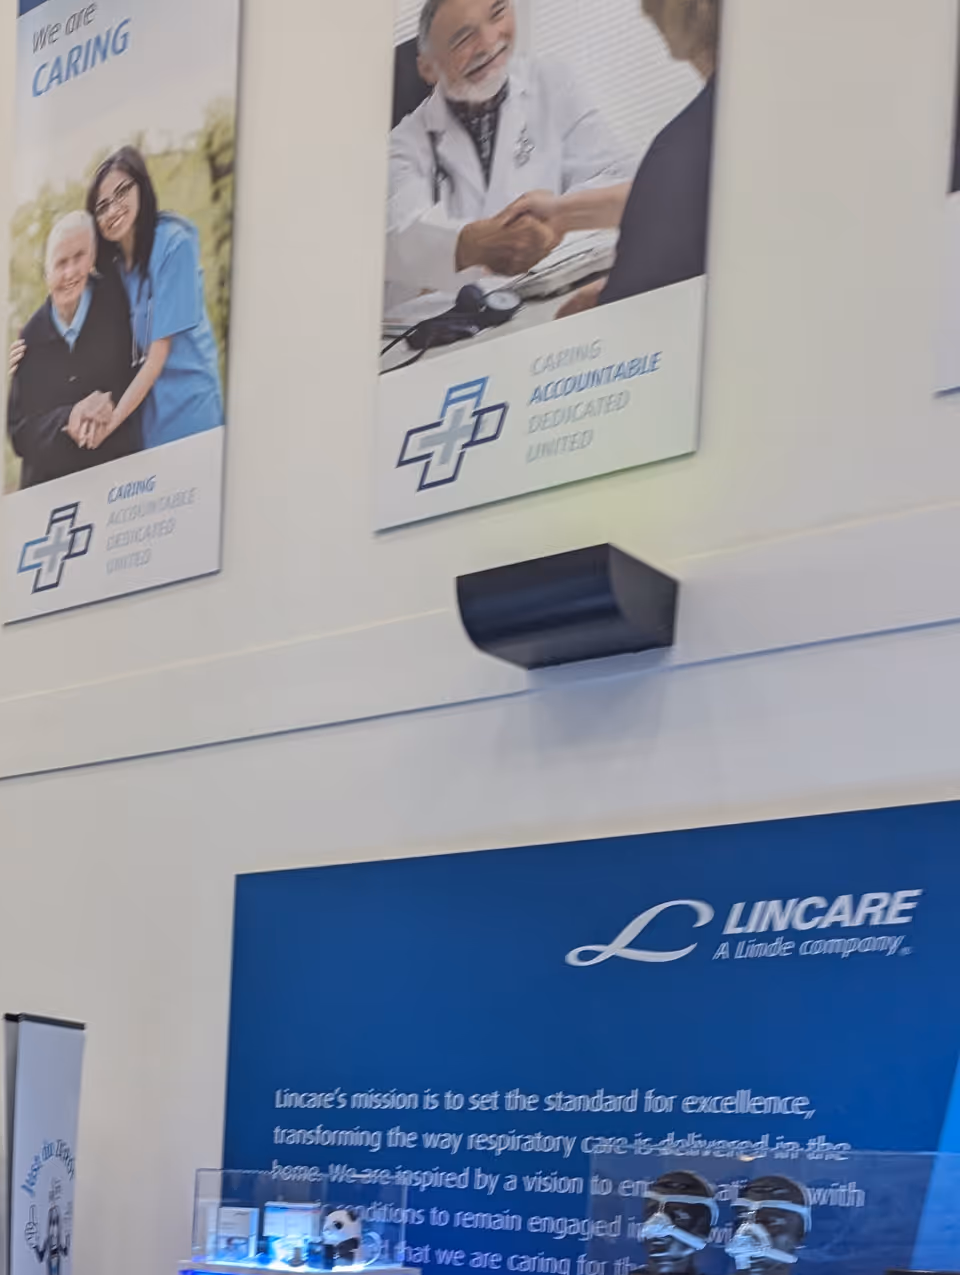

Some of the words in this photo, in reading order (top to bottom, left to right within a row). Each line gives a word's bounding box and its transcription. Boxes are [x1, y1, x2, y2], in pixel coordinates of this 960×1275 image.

[32, 22, 61, 53] We
[65, 3, 97, 36] are
[32, 18, 130, 97] CARING
[529, 338, 603, 376] CARING
[527, 350, 663, 405] ACCOUNTABLE
[527, 389, 631, 433] DEDICATED
[525, 429, 594, 463] UNITED
[107, 475, 156, 504] CARING
[722, 889, 923, 935] LINCARE
[712, 941, 730, 960] A
[734, 936, 795, 959] Linde
[274, 1087, 347, 1109] Lincare's
[351, 1089, 418, 1110] mission
[423, 1089, 439, 1110] is
[444, 1090, 464, 1111] to
[468, 1092, 499, 1112] set
[504, 1088, 539, 1112] the
[543, 1089, 638, 1114] standard
[643, 1089, 677, 1114] for
[681, 1089, 816, 1119] excellence,
[273, 1125, 382, 1152] transforming
[386, 1126, 417, 1149] the
[422, 1131, 464, 1155] way
[467, 1130, 575, 1156] respiratory
[580, 1136, 628, 1155] care
[633, 1133, 652, 1155] is
[657, 1132, 770, 1160] delivered
[774, 1135, 802, 1159] in
[806, 1135, 852, 1160] the
[328, 1163, 358, 1183] We
[395, 1165, 469, 1192] inspired
[474, 1167, 500, 1195] by
[503, 1175, 518, 1191] a
[522, 1171, 583, 1194] vision
[589, 1174, 613, 1196] to
[809, 1181, 865, 1207] with
[430, 1206, 450, 1226] to
[453, 1209, 522, 1232] remain
[527, 1214, 622, 1241] engaged
[435, 1248, 466, 1266] we
[469, 1251, 502, 1269] are
[577, 1253, 606, 1275] for
